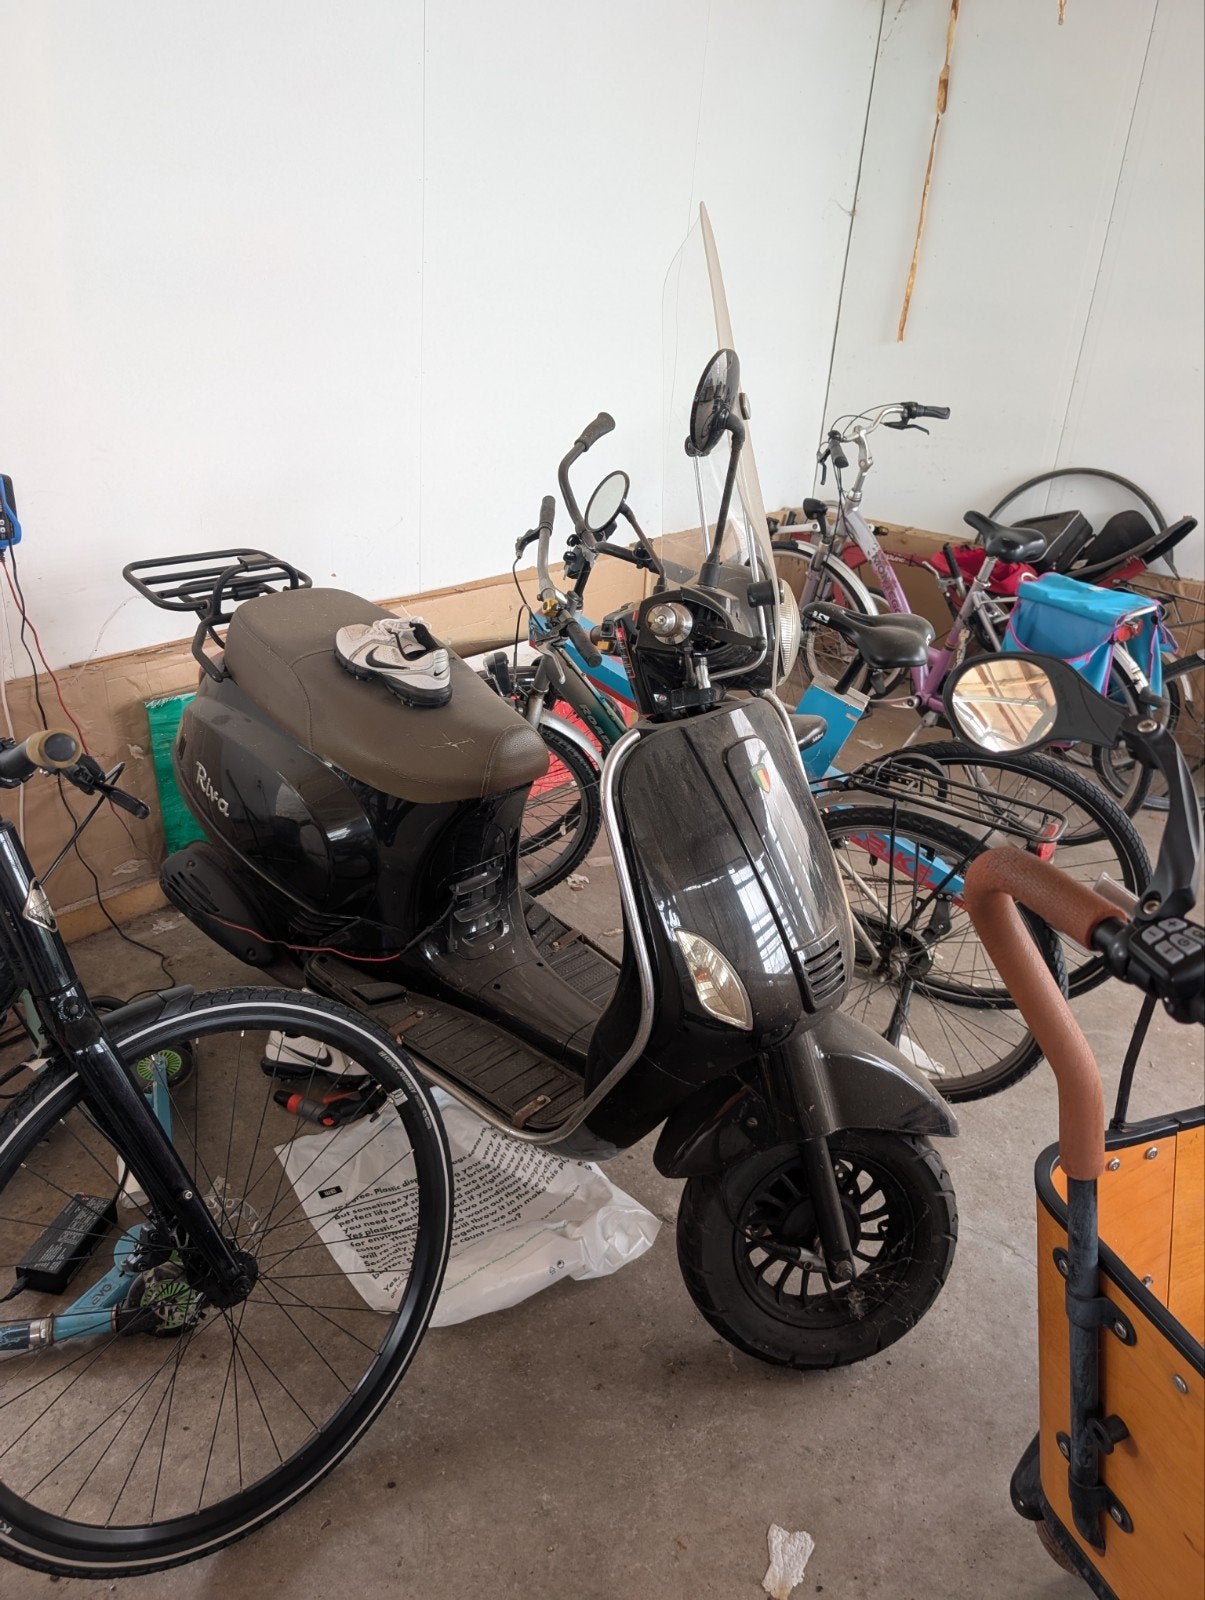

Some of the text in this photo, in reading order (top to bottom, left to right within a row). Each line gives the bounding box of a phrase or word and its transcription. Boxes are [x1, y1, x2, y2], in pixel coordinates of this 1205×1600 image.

[195, 760, 230, 818] Riva
[334, 1211, 351, 1220] But
[352, 1198, 402, 1214] sometimes
[461, 1160, 482, 1174] your
[482, 1140, 494, 1160] very
[338, 1212, 373, 1228] perfect
[373, 1207, 391, 1217] life
[391, 1202, 409, 1213] and
[466, 1163, 491, 1178] bring
[490, 1141, 502, 1164] your
[342, 1224, 362, 1235] you
[363, 1217, 388, 1227] need
[389, 1211, 410, 1221] one.
[462, 1179, 477, 1188] we
[346, 1232, 363, 1240] Yes
[364, 1223, 398, 1237] plastic.
[398, 1212, 419, 1225] Part
[464, 1184, 481, 1196] and
[482, 1172, 502, 1187] right
[502, 1154, 516, 1174] now
[350, 1240, 365, 1248] for
[368, 1222, 418, 1244] environme
[453, 1200, 468, 1208] act
[468, 1194, 475, 1202] if
[476, 1186, 493, 1198] you
[494, 1156, 525, 1188] compare
[355, 1242, 390, 1254] cotton.
[459, 1203, 477, 1214] two
[479, 1174, 525, 1205] conditions.
[359, 1252, 377, 1260] will
[379, 1240, 408, 1256] re-use
[454, 1217, 464, 1225] so
[465, 1206, 490, 1219] worn
[490, 1196, 504, 1207] out
[504, 1185, 521, 1198] that
[522, 1159, 543, 1189] people
[374, 1186, 401, 1195] Plastic
[402, 1177, 418, 1188] disp
[452, 1155, 467, 1165] ags
[451, 1221, 490, 1240] ogether
[491, 1214, 506, 1223] we
[507, 1204, 523, 1216] can
[524, 1185, 547, 1205] make
[545, 1169, 559, 1185] this
[364, 1245, 410, 1267] Secondly,
[452, 1221, 470, 1232] will
[470, 1210, 497, 1224] throw
[505, 1199, 515, 1207] in
[515, 1190, 530, 1201] the
[460, 1231, 485, 1243] count
